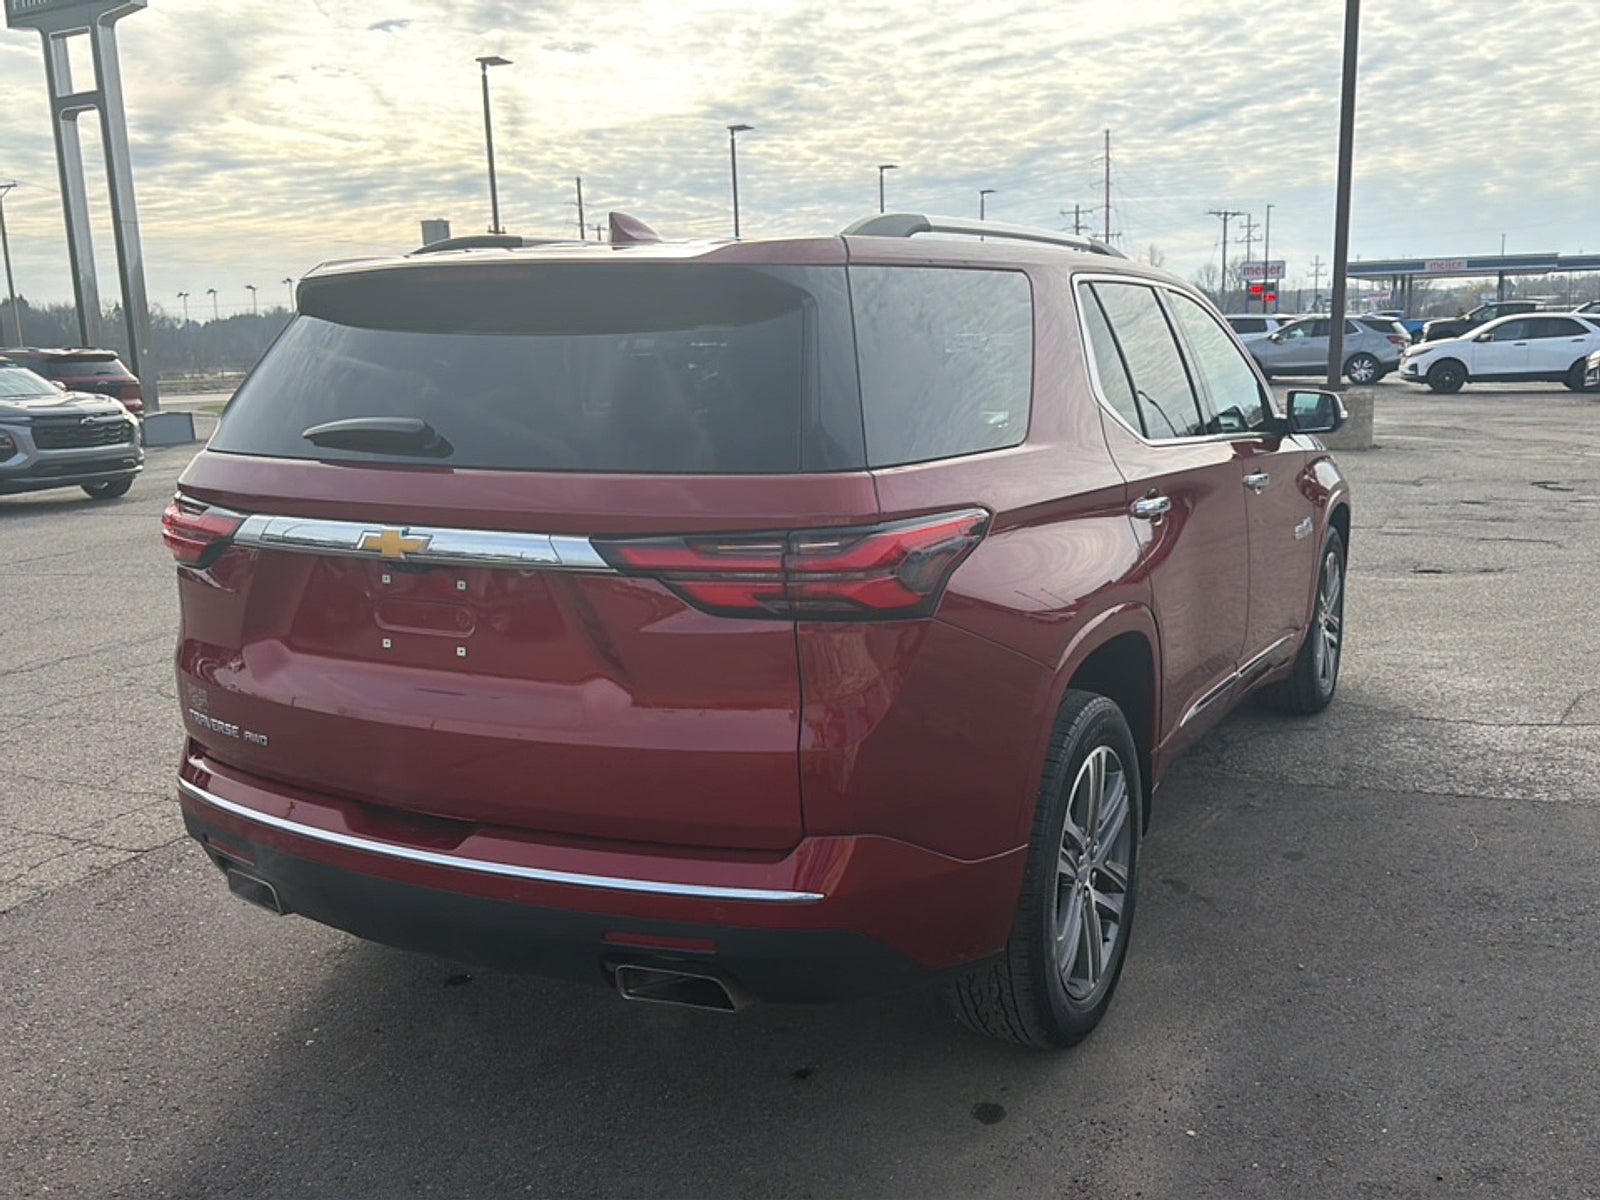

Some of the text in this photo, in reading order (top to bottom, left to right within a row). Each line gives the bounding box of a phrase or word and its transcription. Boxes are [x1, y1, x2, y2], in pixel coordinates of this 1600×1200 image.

[1243, 264, 1281, 276] meier
[189, 708, 269, 747] TRAVERSE AWD
